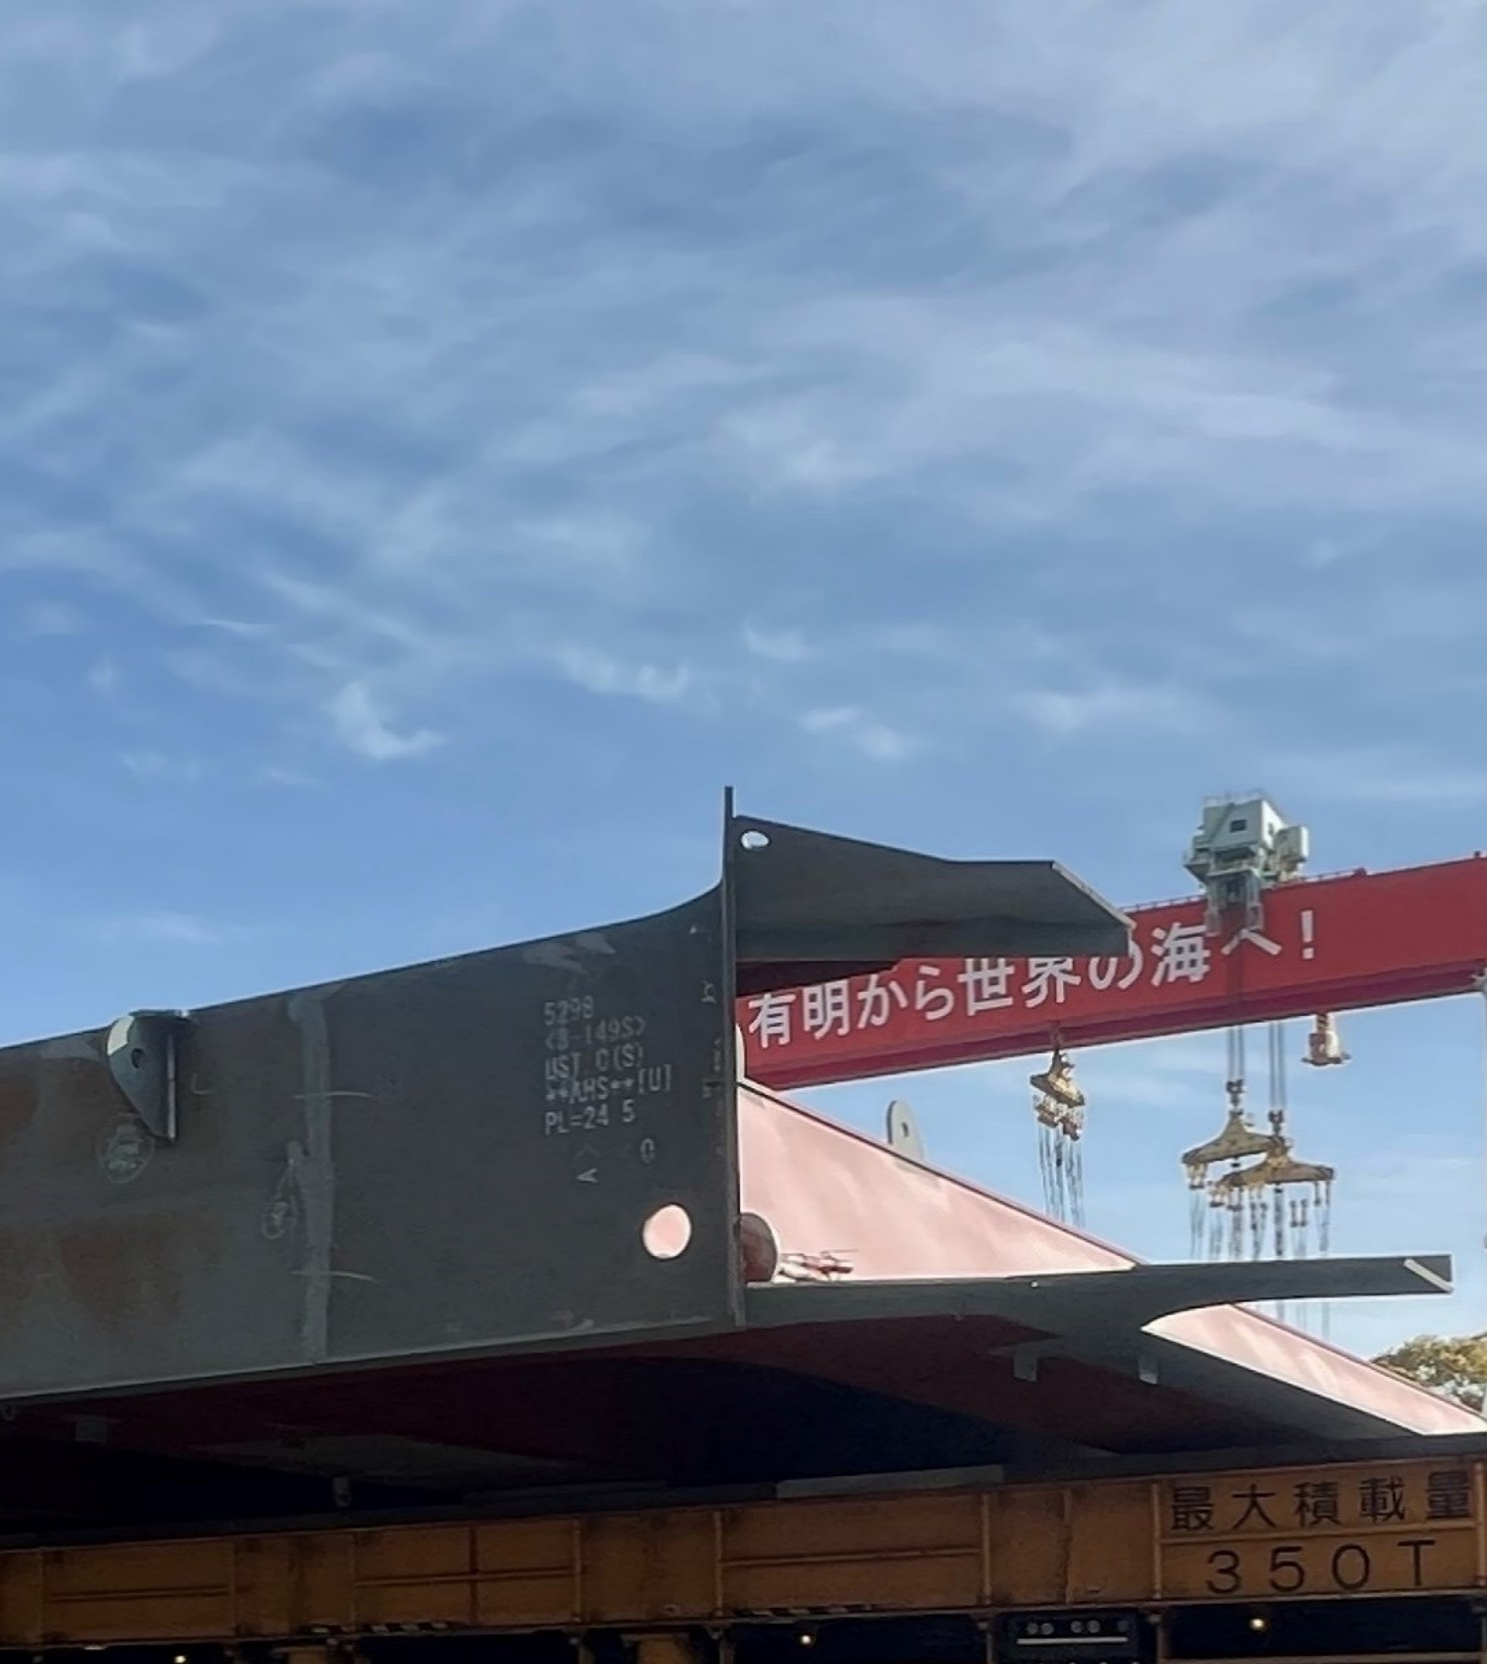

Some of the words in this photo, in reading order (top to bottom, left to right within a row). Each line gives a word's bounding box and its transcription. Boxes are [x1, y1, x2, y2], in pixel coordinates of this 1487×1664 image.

[1169, 1469, 1471, 1532] 最大積載量
[1205, 1538, 1436, 1595] 350T
